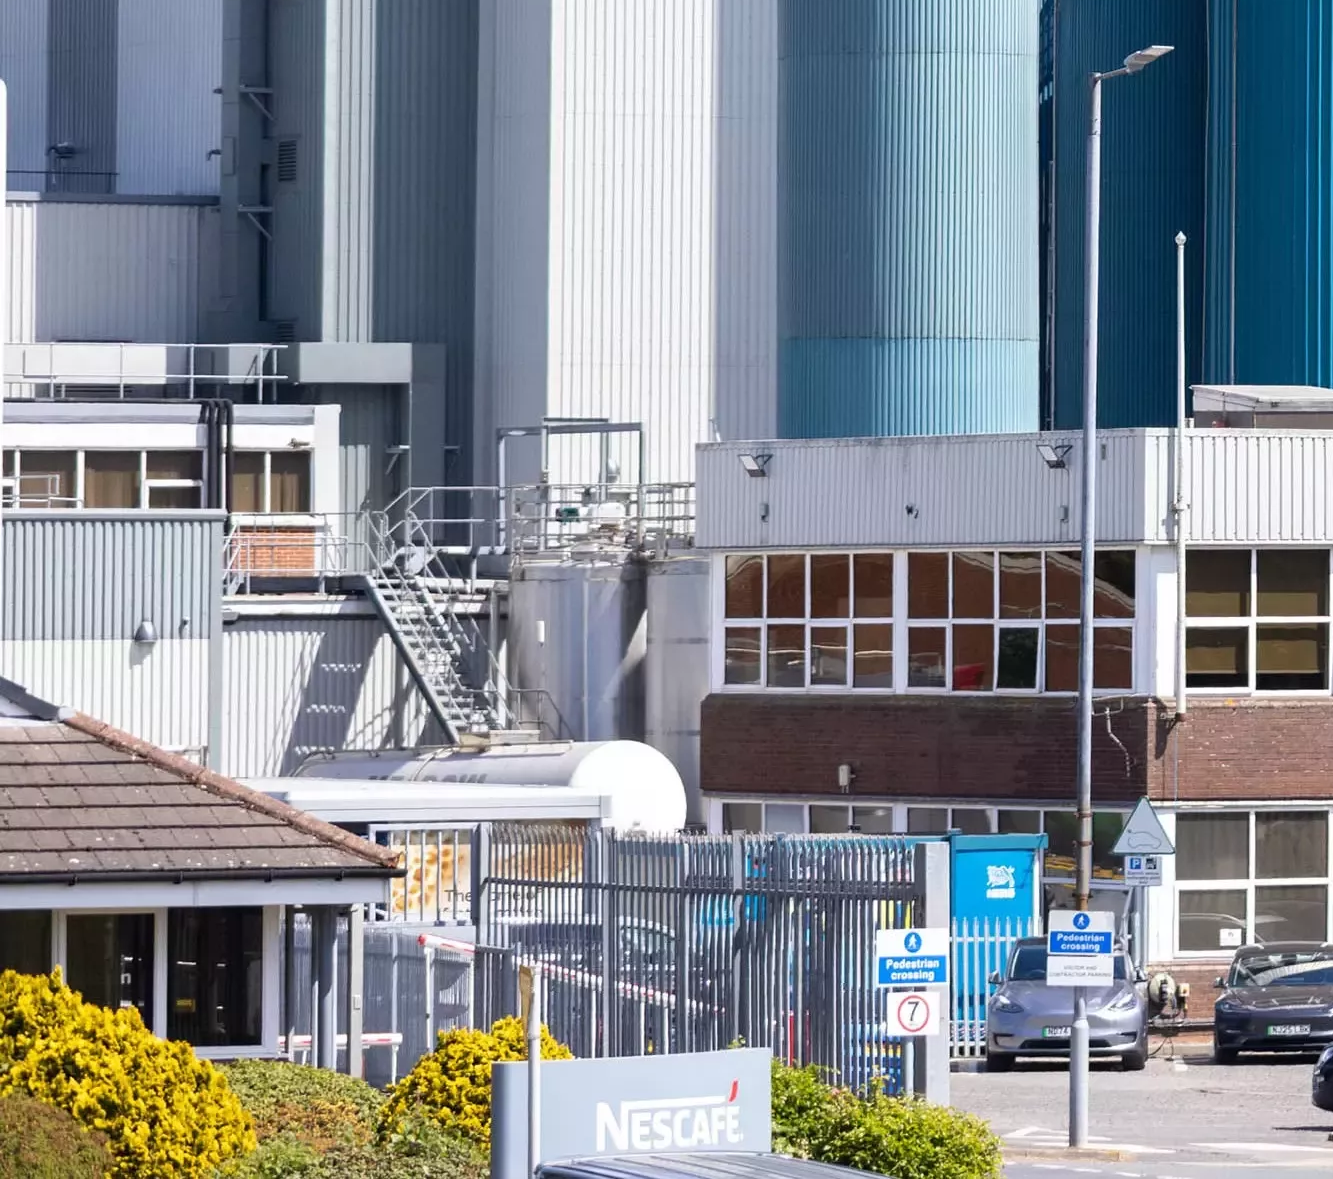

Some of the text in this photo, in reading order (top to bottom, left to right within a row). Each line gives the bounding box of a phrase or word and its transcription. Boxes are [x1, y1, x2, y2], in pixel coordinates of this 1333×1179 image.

[1057, 933, 1105, 942] Pedestrian
[1061, 943, 1100, 952] crossing
[886, 958, 940, 970] Pedestrian
[891, 970, 935, 981] crossing
[908, 1001, 919, 1022] 7
[596, 1078, 742, 1152] NESCAFÉ
